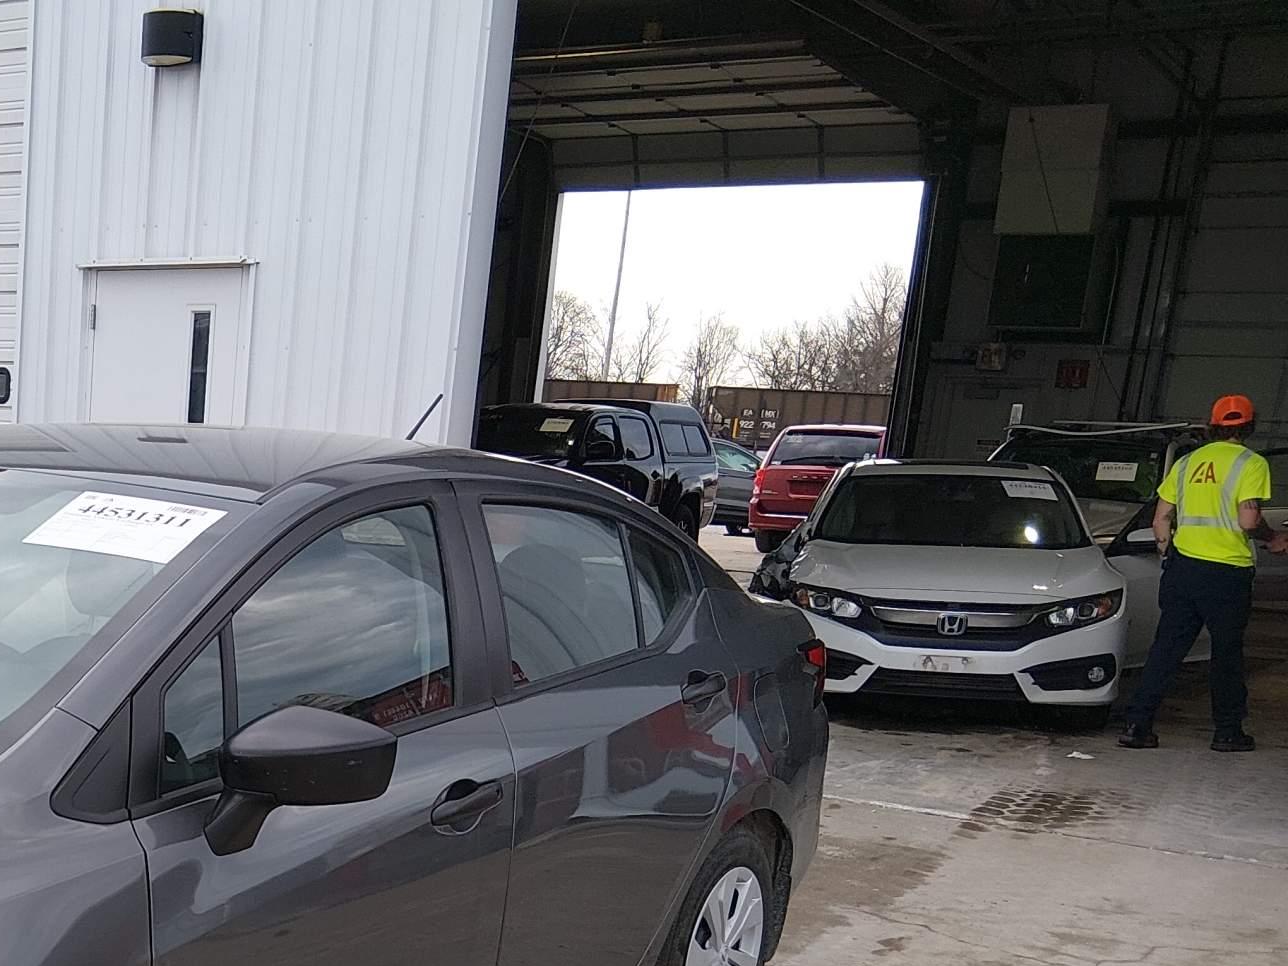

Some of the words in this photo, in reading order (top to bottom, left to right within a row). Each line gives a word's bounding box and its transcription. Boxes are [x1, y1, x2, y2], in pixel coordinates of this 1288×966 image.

[739, 420, 754, 429] 922
[760, 421, 776, 429] 794
[78, 504, 192, 528] 44531311
